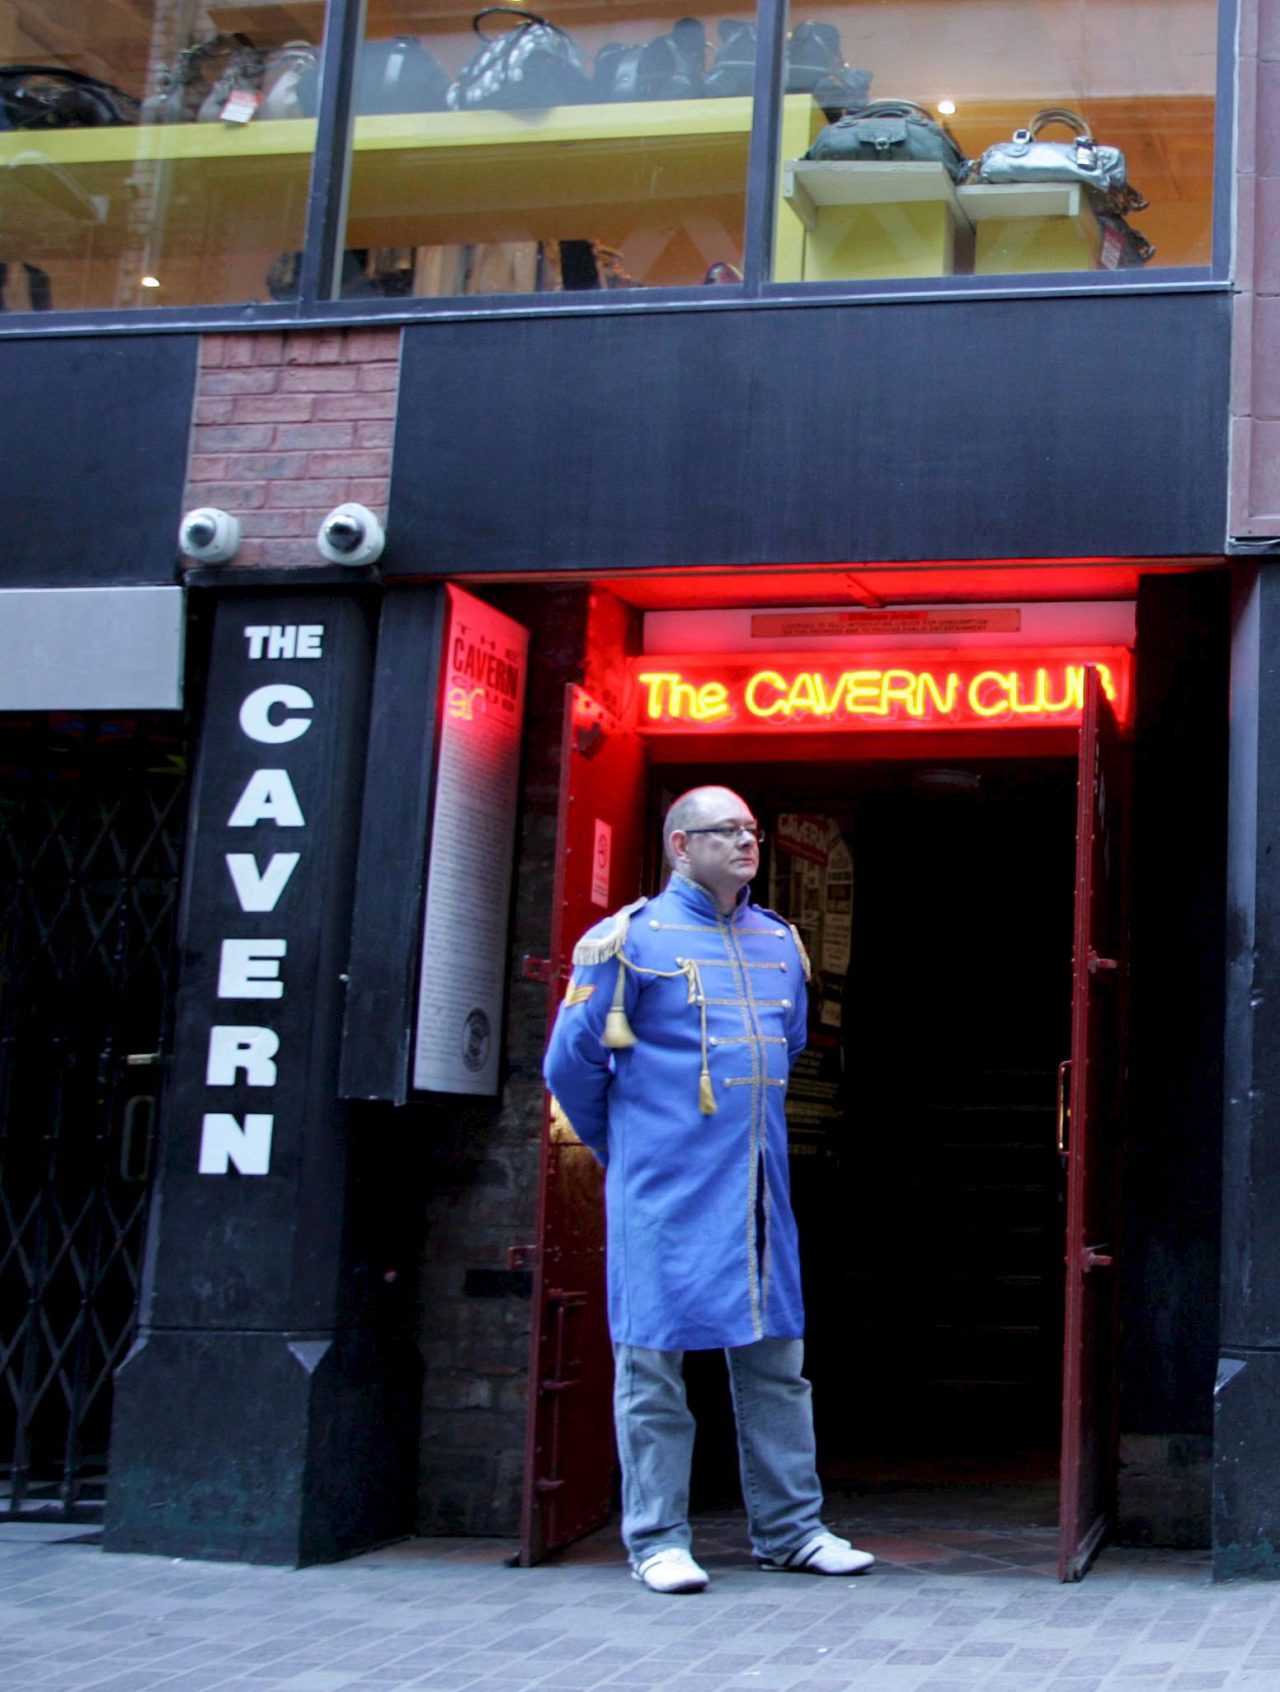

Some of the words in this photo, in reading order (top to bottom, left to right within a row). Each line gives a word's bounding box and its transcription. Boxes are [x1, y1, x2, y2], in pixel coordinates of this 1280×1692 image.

[245, 624, 324, 660] THE
[453, 637, 519, 700] CAVERN
[639, 671, 729, 720] The
[743, 668, 961, 718] CAVERN
[198, 684, 316, 1176] CAVERN
